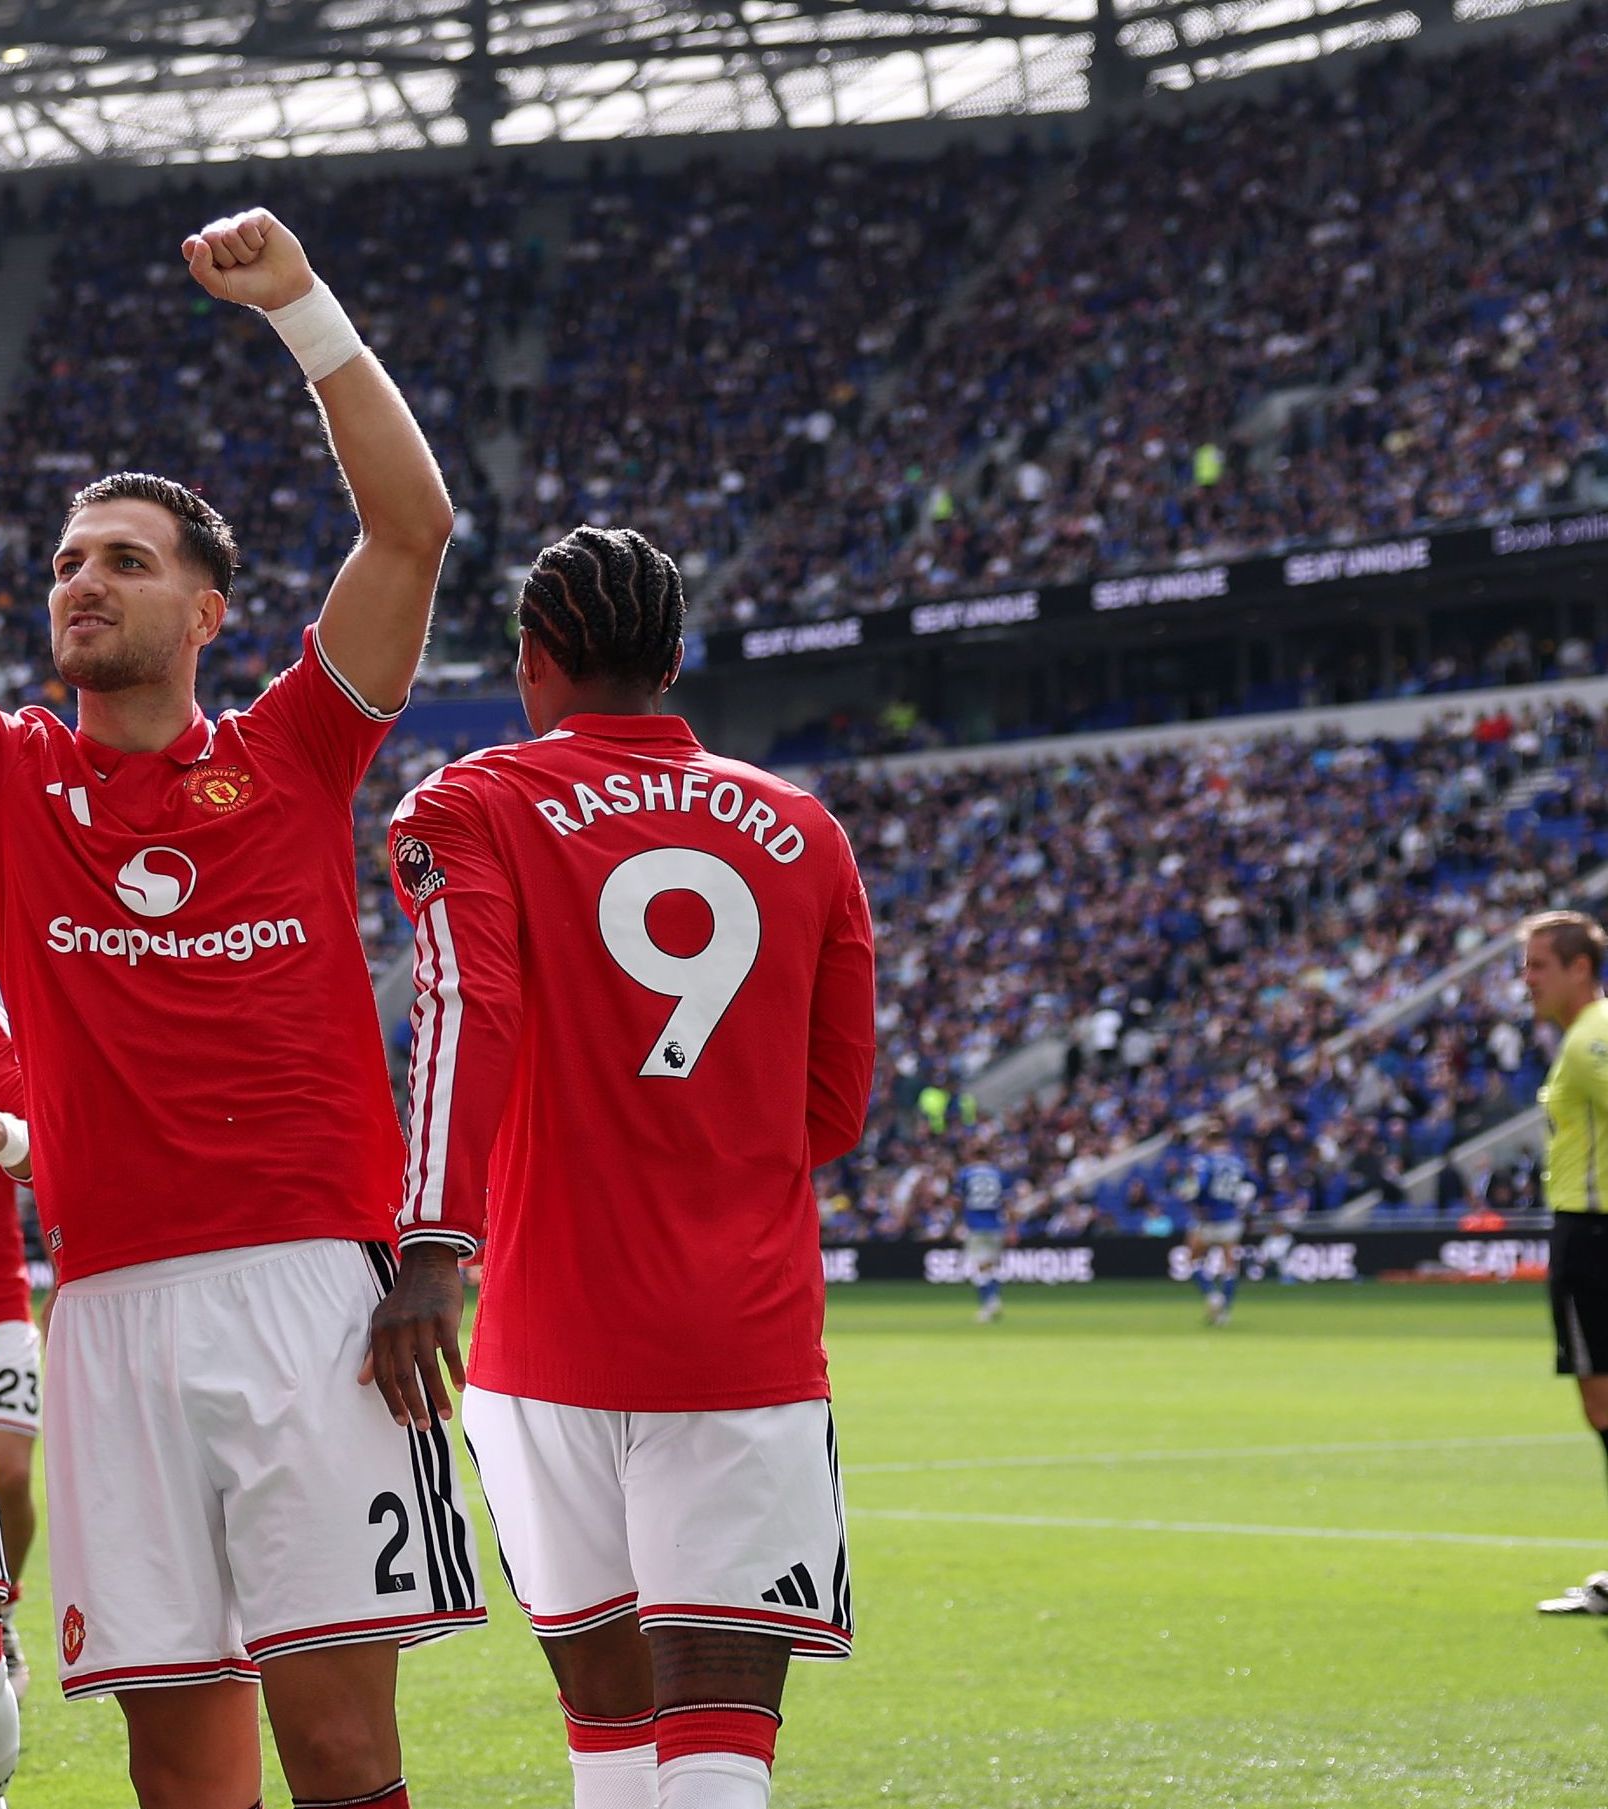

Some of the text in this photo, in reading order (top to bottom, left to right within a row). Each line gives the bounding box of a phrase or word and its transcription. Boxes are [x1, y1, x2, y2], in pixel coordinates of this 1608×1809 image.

[535, 773, 806, 864] RASHFORD
[47, 915, 307, 967] Snapdragon
[598, 847, 762, 1080] 9
[369, 1491, 417, 1595] 2
